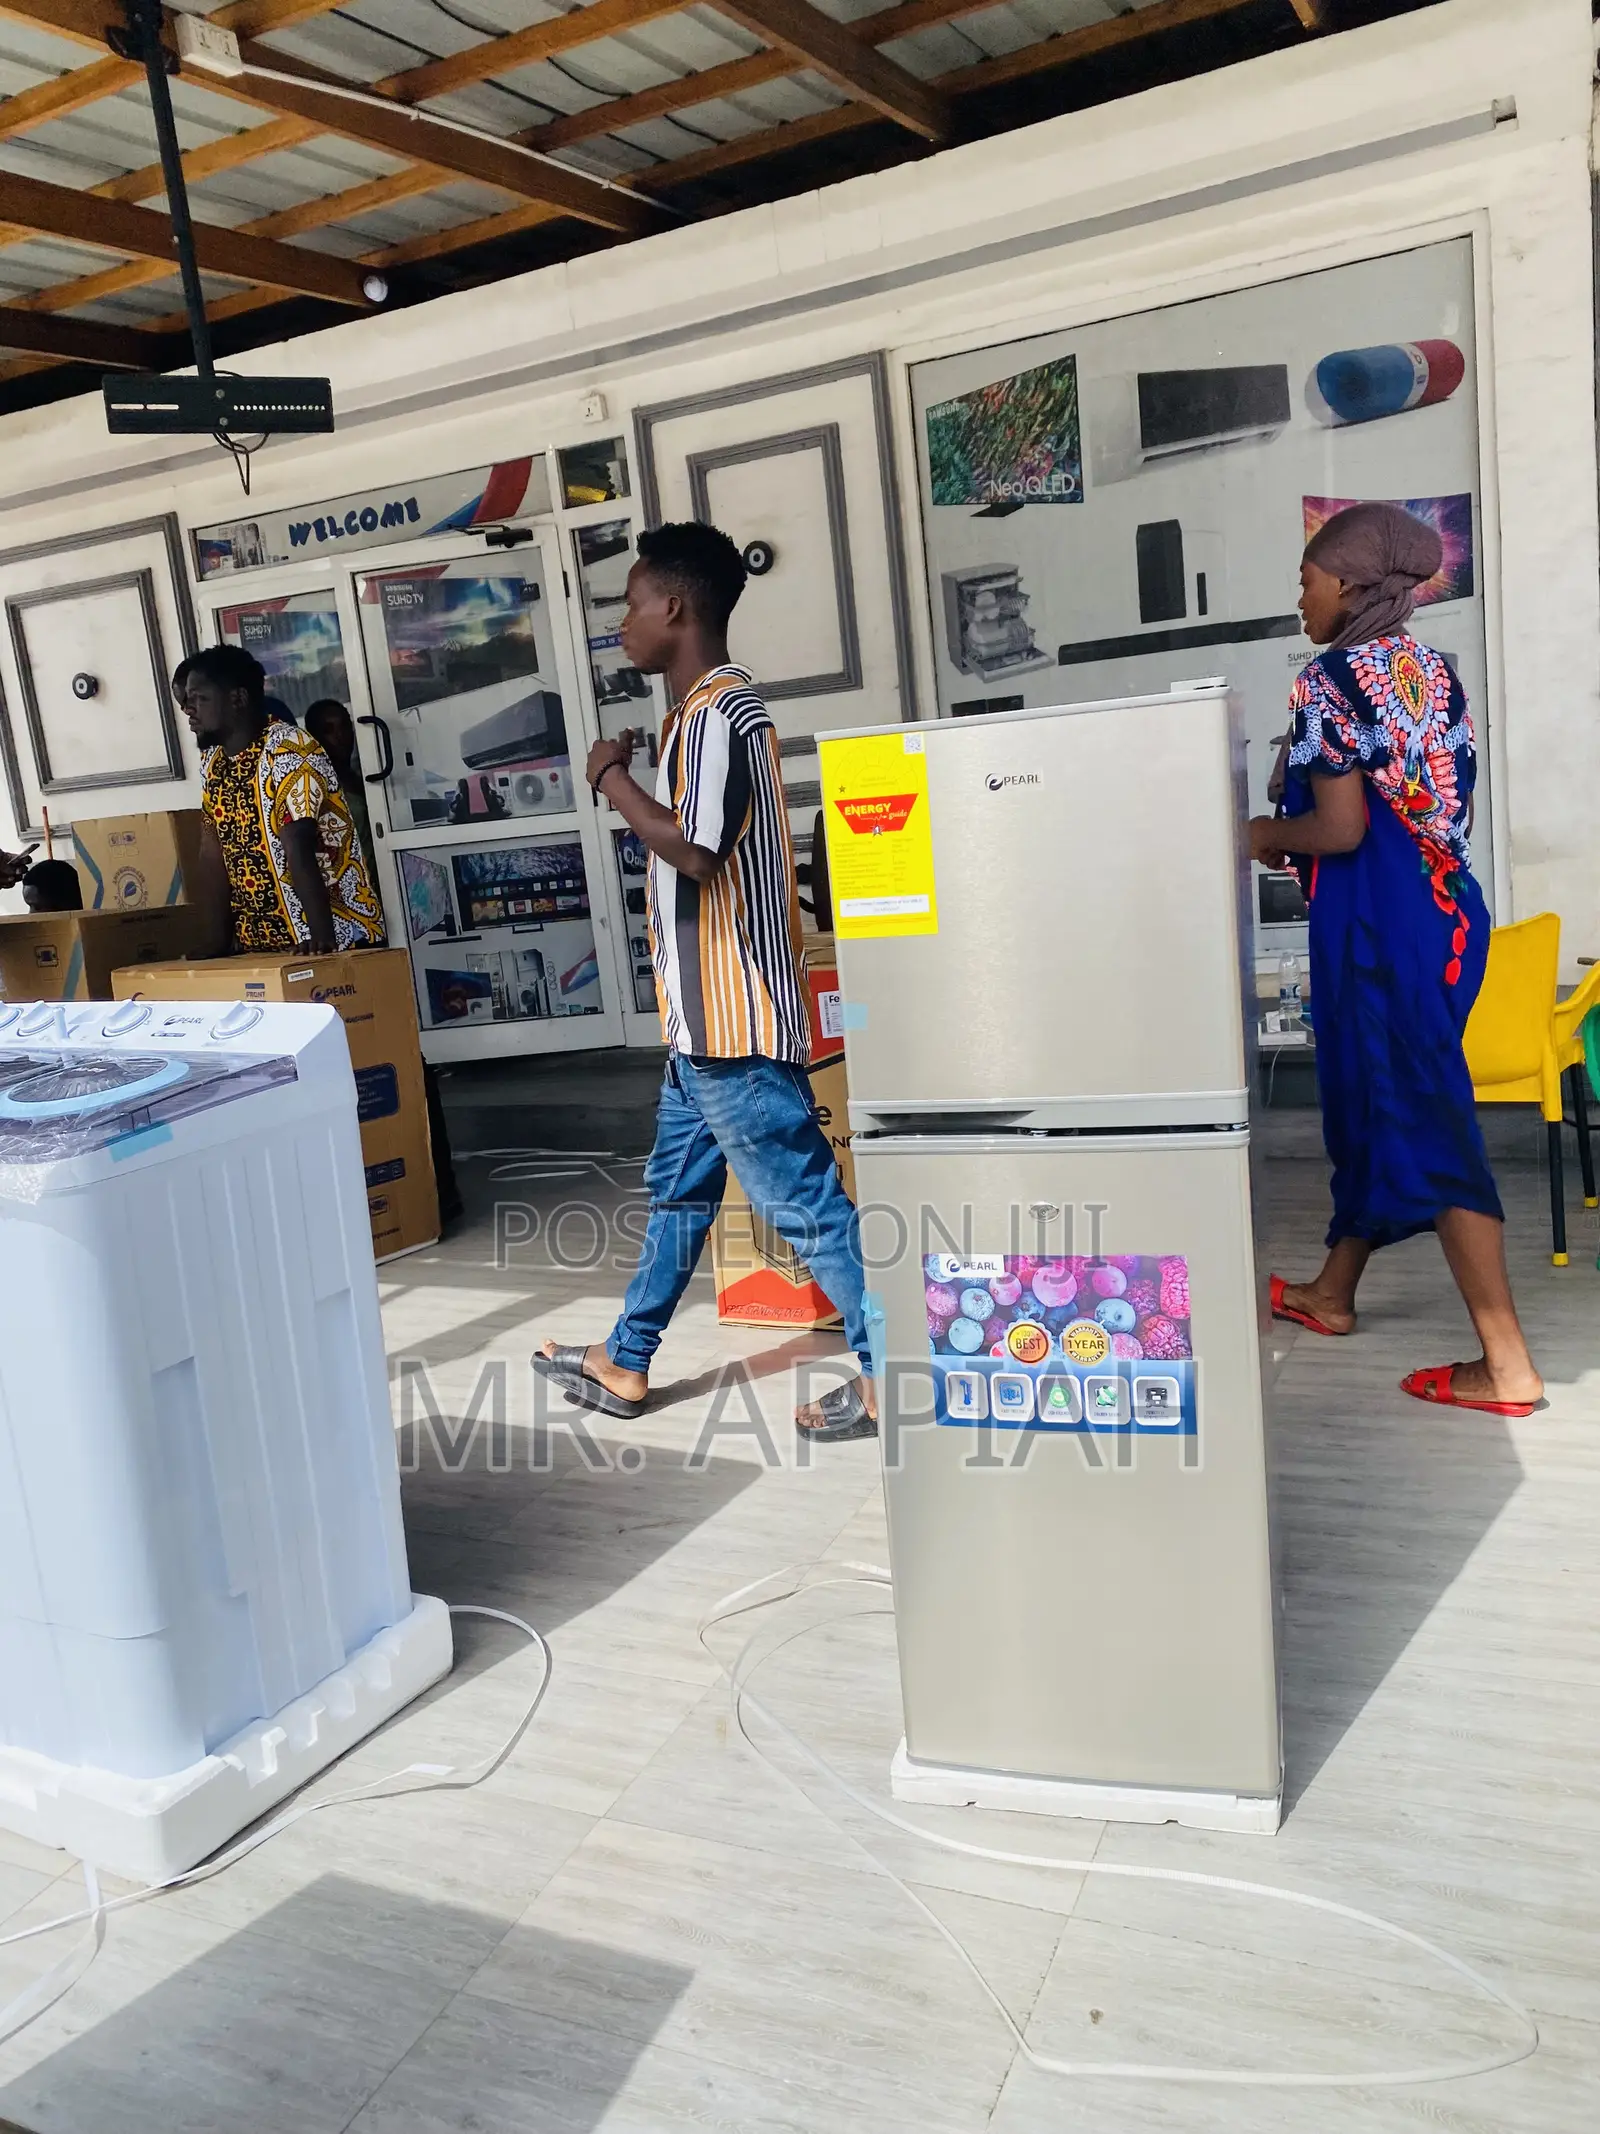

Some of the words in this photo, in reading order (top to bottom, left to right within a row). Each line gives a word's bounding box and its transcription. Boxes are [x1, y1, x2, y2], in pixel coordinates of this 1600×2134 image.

[990, 480, 1022, 497] Neo
[1026, 474, 1075, 495] QLED
[288, 497, 421, 547] WELCOME
[413, 593, 424, 603] TV
[1287, 651, 1312, 662] SUHD
[1003, 774, 1041, 786] PEARL
[844, 803, 892, 817] ENERGY
[888, 809, 908, 820] guide
[326, 984, 357, 998] PEARL
[828, 995, 840, 1003] Fe
[963, 1261, 997, 1271] PEARL
[1069, 1326, 1102, 1338] WARRANTY
[1015, 1338, 1041, 1350] BEST
[1073, 1339, 1105, 1350] YEAR
